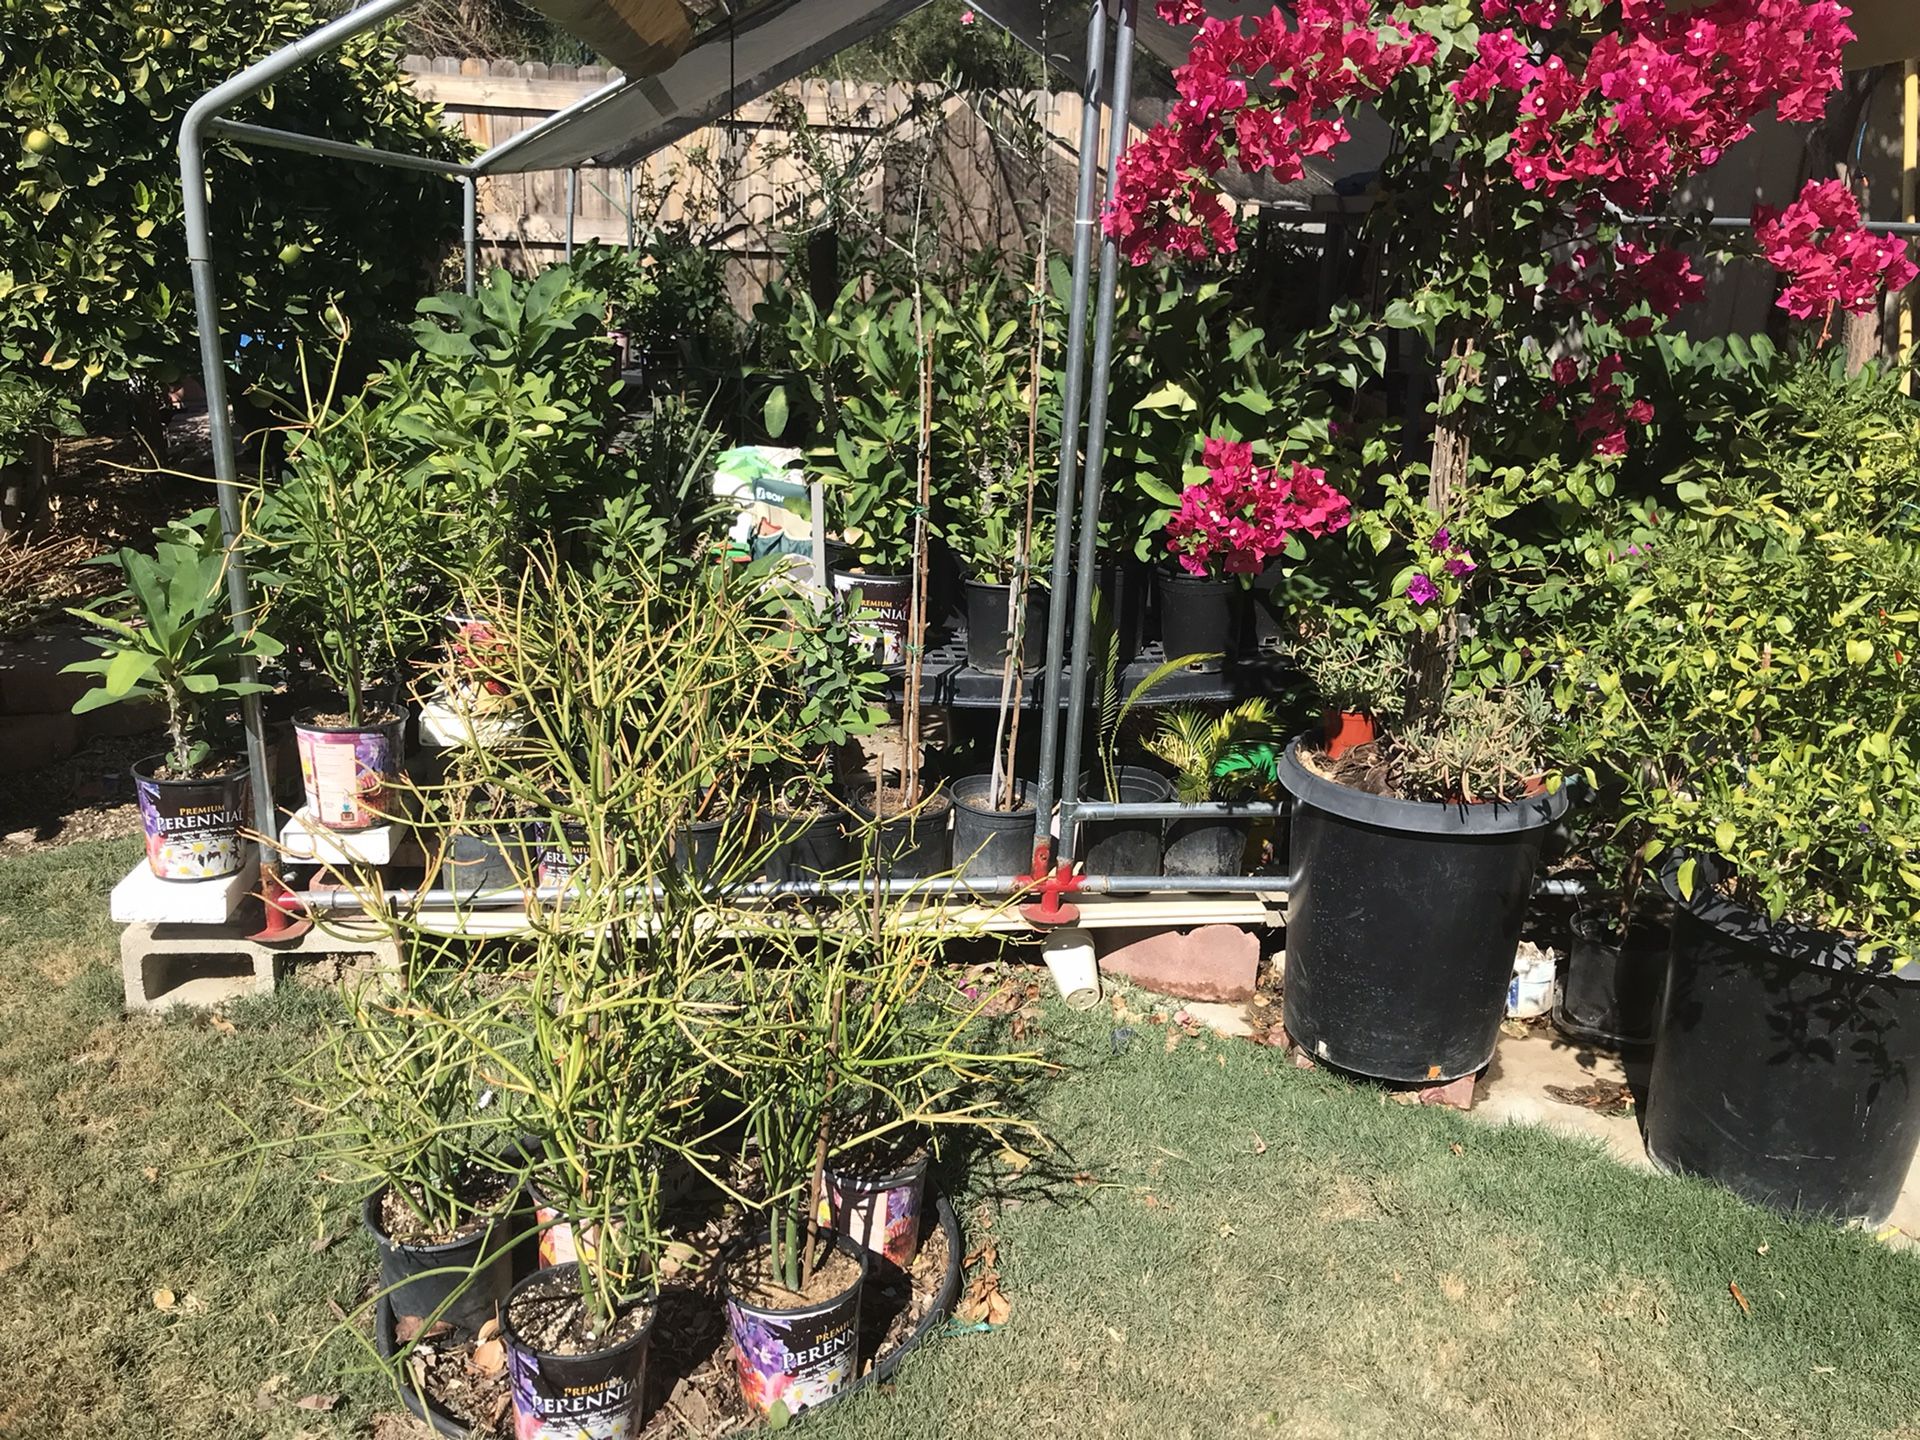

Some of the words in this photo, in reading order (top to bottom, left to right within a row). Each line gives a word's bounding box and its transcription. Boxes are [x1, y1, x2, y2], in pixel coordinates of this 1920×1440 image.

[861, 599, 893, 608] REMIUM
[157, 810, 243, 831] PERENNIAL
[179, 805, 225, 816] PREMIUM
[781, 1326, 856, 1370] PERENN
[531, 1377, 640, 1414] PERENNIA
